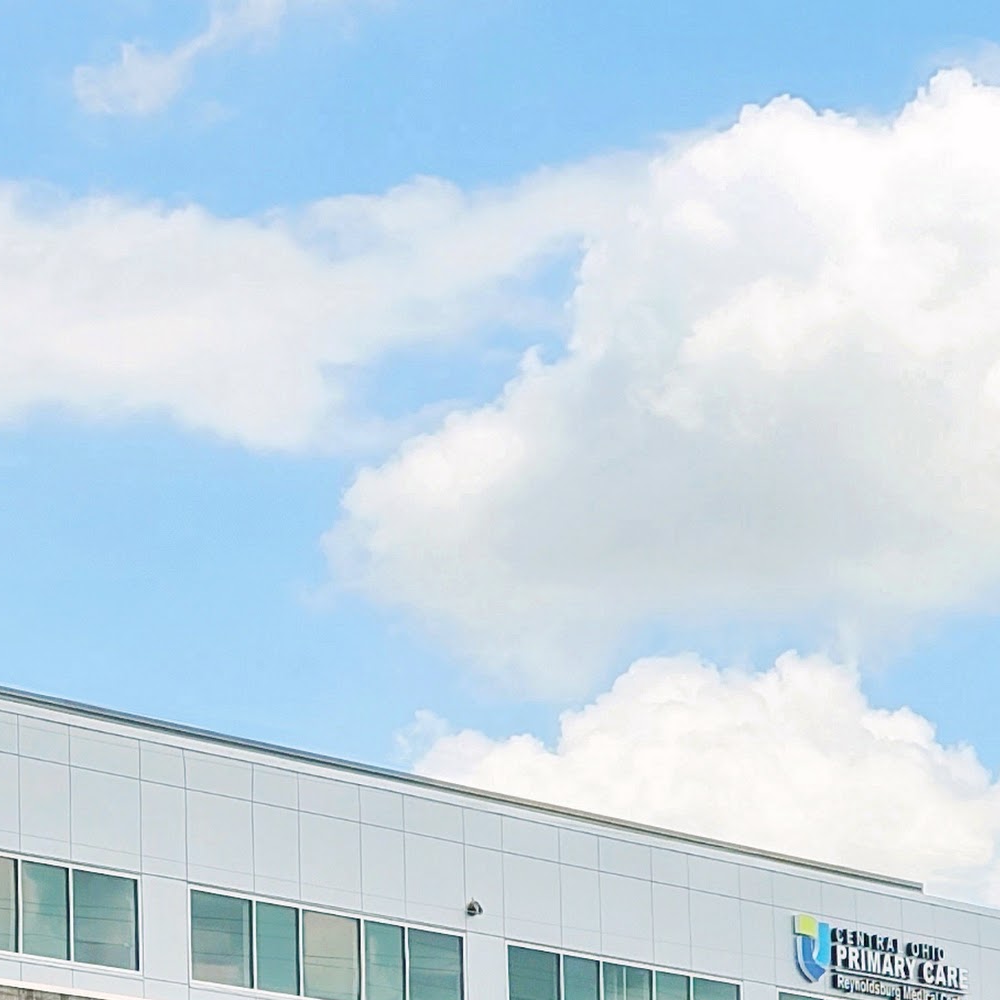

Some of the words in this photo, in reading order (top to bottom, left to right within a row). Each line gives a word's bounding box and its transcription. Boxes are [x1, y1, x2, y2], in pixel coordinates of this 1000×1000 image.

[835, 929, 904, 955] CENTRAL
[911, 943, 946, 961] OHIO
[836, 945, 917, 980] PRIMARY
[923, 962, 969, 990] CARE
[837, 976, 901, 1000] Reynoldsburg
